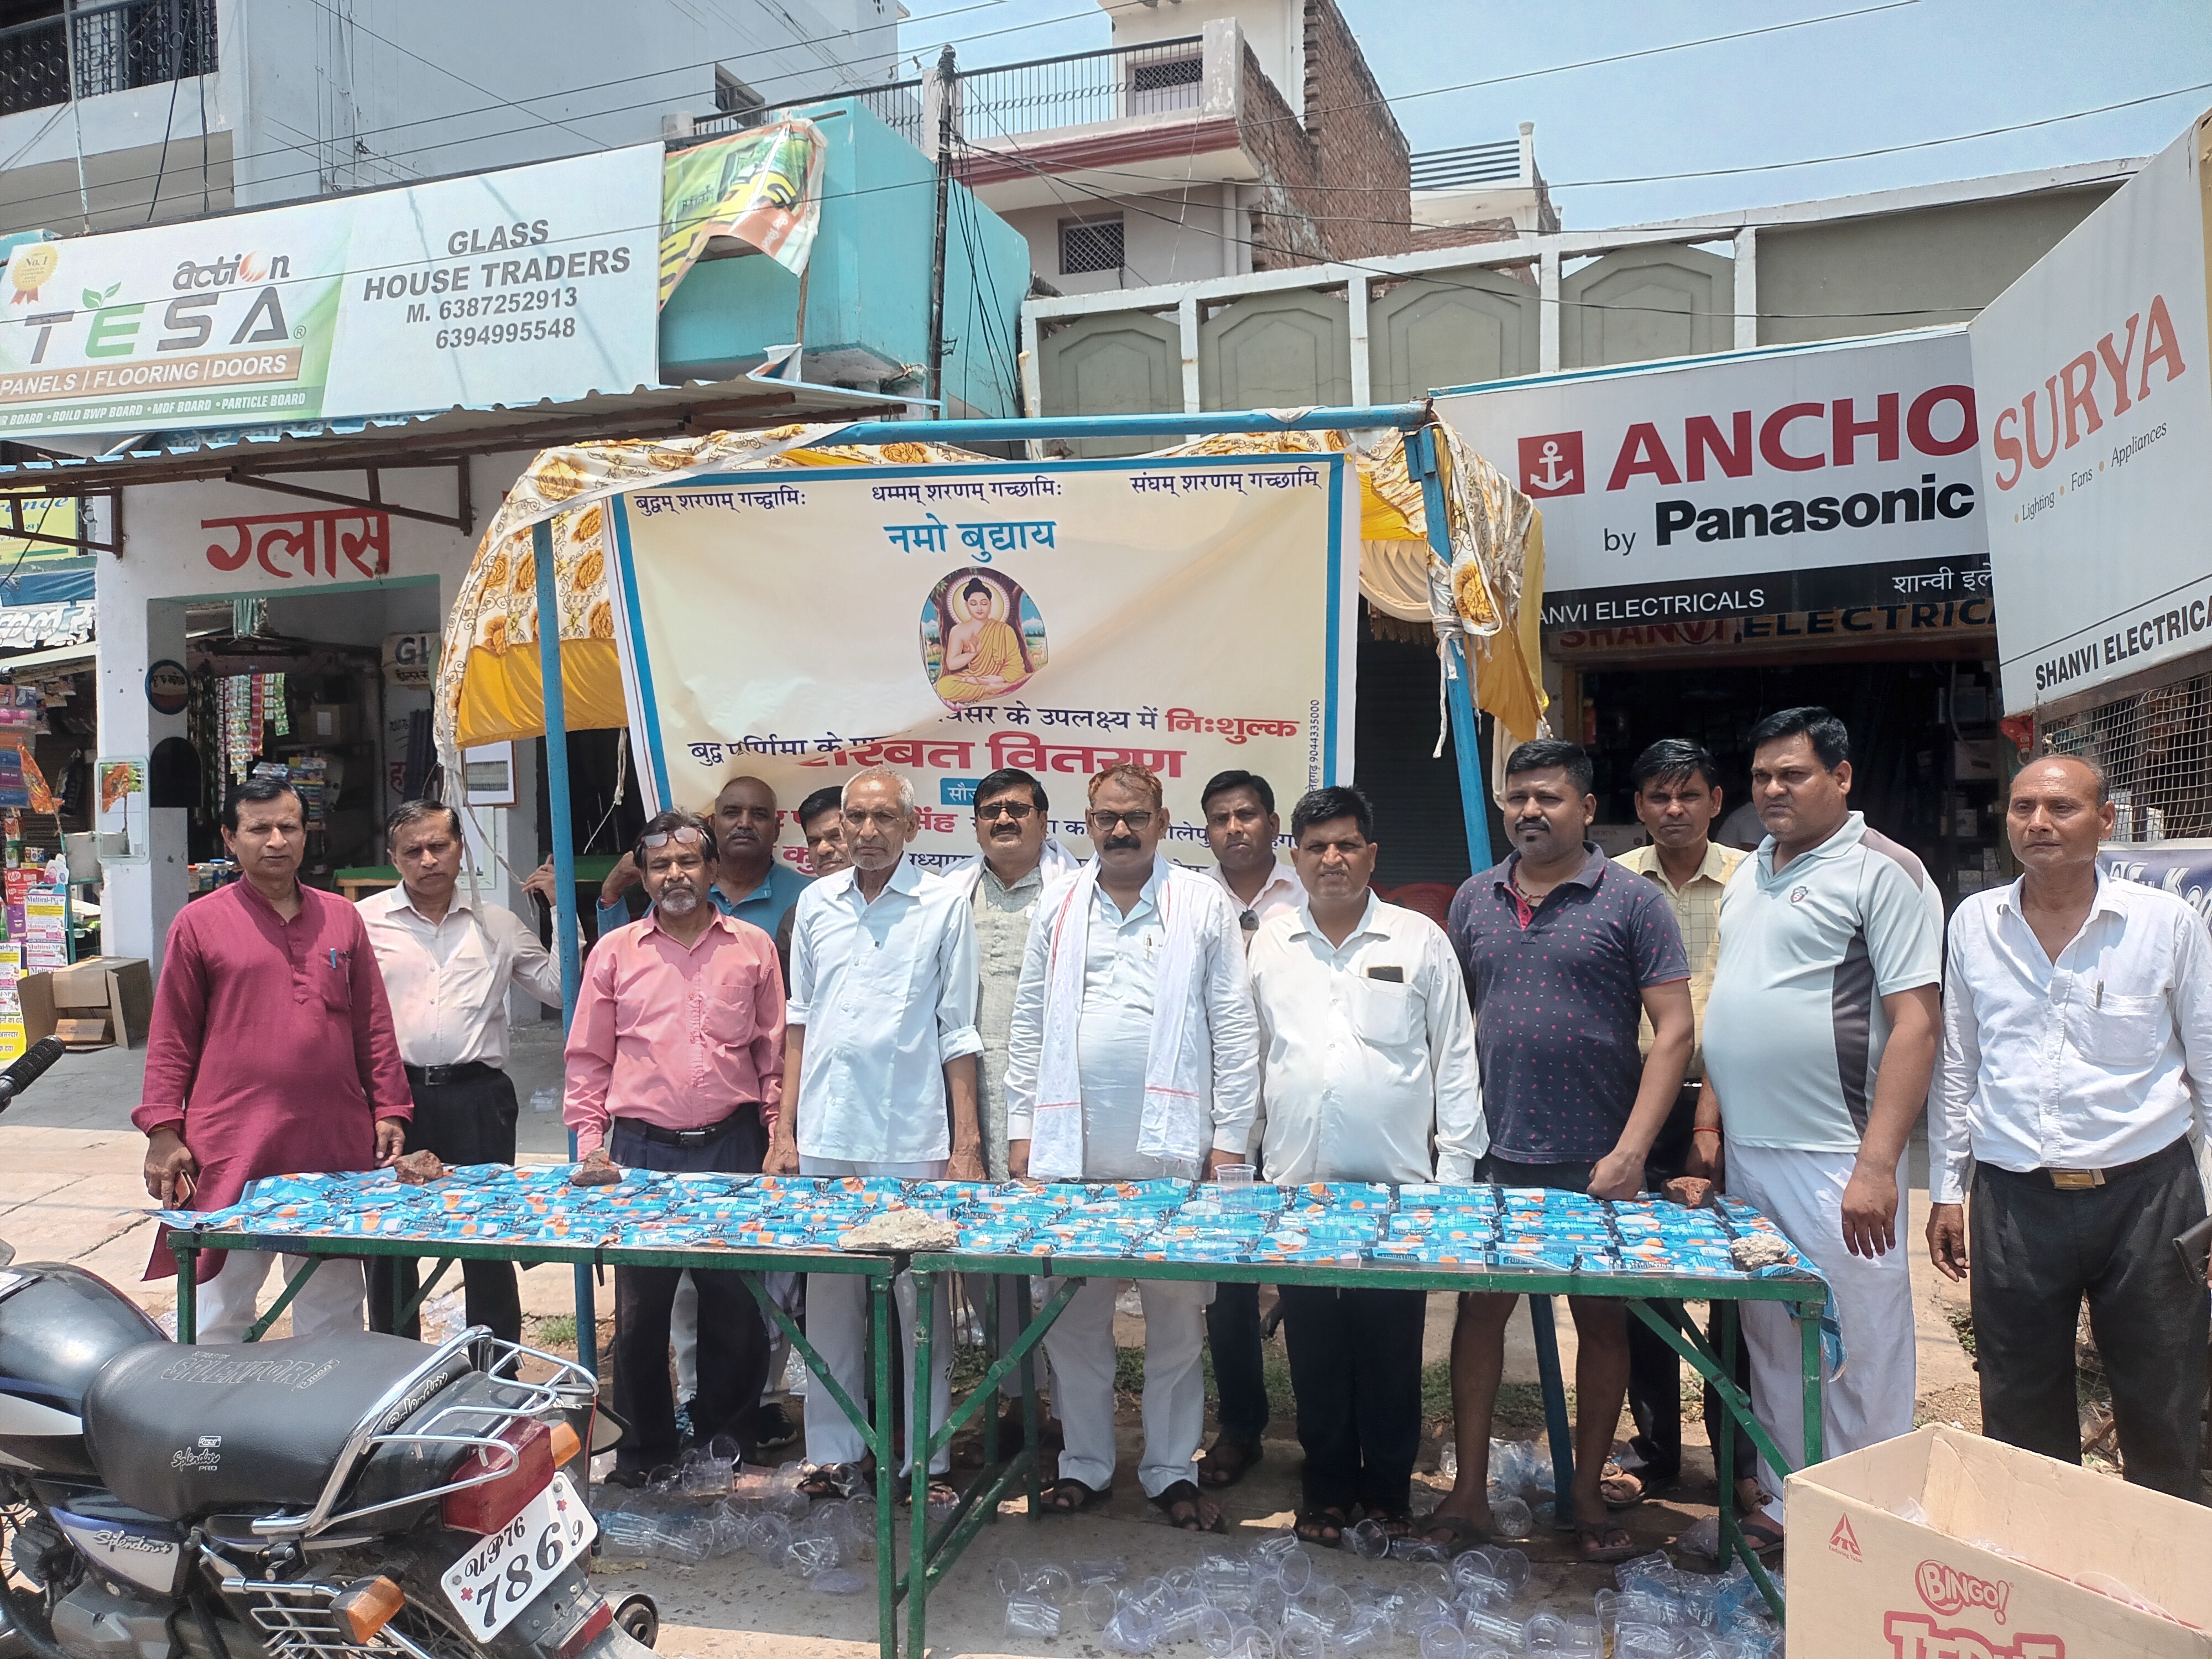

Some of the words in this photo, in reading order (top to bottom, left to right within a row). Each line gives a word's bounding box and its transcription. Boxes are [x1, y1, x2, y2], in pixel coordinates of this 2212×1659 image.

[448, 219, 549, 255] GLASS
[363, 265, 470, 301] HOUSE
[481, 246, 630, 287] TRADERS
[24, 286, 289, 364] TESA
[406, 304, 431, 324] M.
[439, 287, 578, 320] 6387252913
[436, 317, 576, 349] 6394995548
[0, 373, 77, 396] PANELS
[93, 362, 199, 388] FLOORING
[212, 354, 287, 378] DOORS
[1994, 294, 2185, 492] SURYA
[9, 413, 43, 425] BOARD
[83, 407, 107, 420] BWP
[109, 405, 143, 418] BOARD
[152, 402, 175, 414] MDF
[177, 399, 212, 413] BOARD
[221, 395, 268, 410] PARTICLE
[270, 393, 306, 406] BOARD
[1605, 384, 1979, 492] ANCHO
[1129, 472, 1180, 498] संघम्
[1180, 473, 1248, 495] शरणम्
[2022, 488, 2055, 521] Lighting
[2072, 467, 2093, 492] Fans
[2111, 421, 2167, 468] Appliances
[676, 493, 740, 513] शरणम्
[872, 486, 926, 506] धम्मम्
[925, 483, 990, 504] शरणम्
[1604, 528, 1636, 556] by
[1655, 472, 1974, 546] Panasonic
[201, 507, 391, 578] ग्लास
[883, 513, 949, 554] नमो
[1596, 588, 1765, 620] ELECTRICALS
[2035, 643, 2099, 691] SHANVI
[813, 731, 843, 752] के
[1003, 700, 1031, 726] के
[1036, 707, 1131, 733] उपलक्ष्य
[1136, 706, 1159, 730] में
[1165, 708, 1301, 745] निःशुल्क
[1310, 700, 1319, 762] 9044335000
